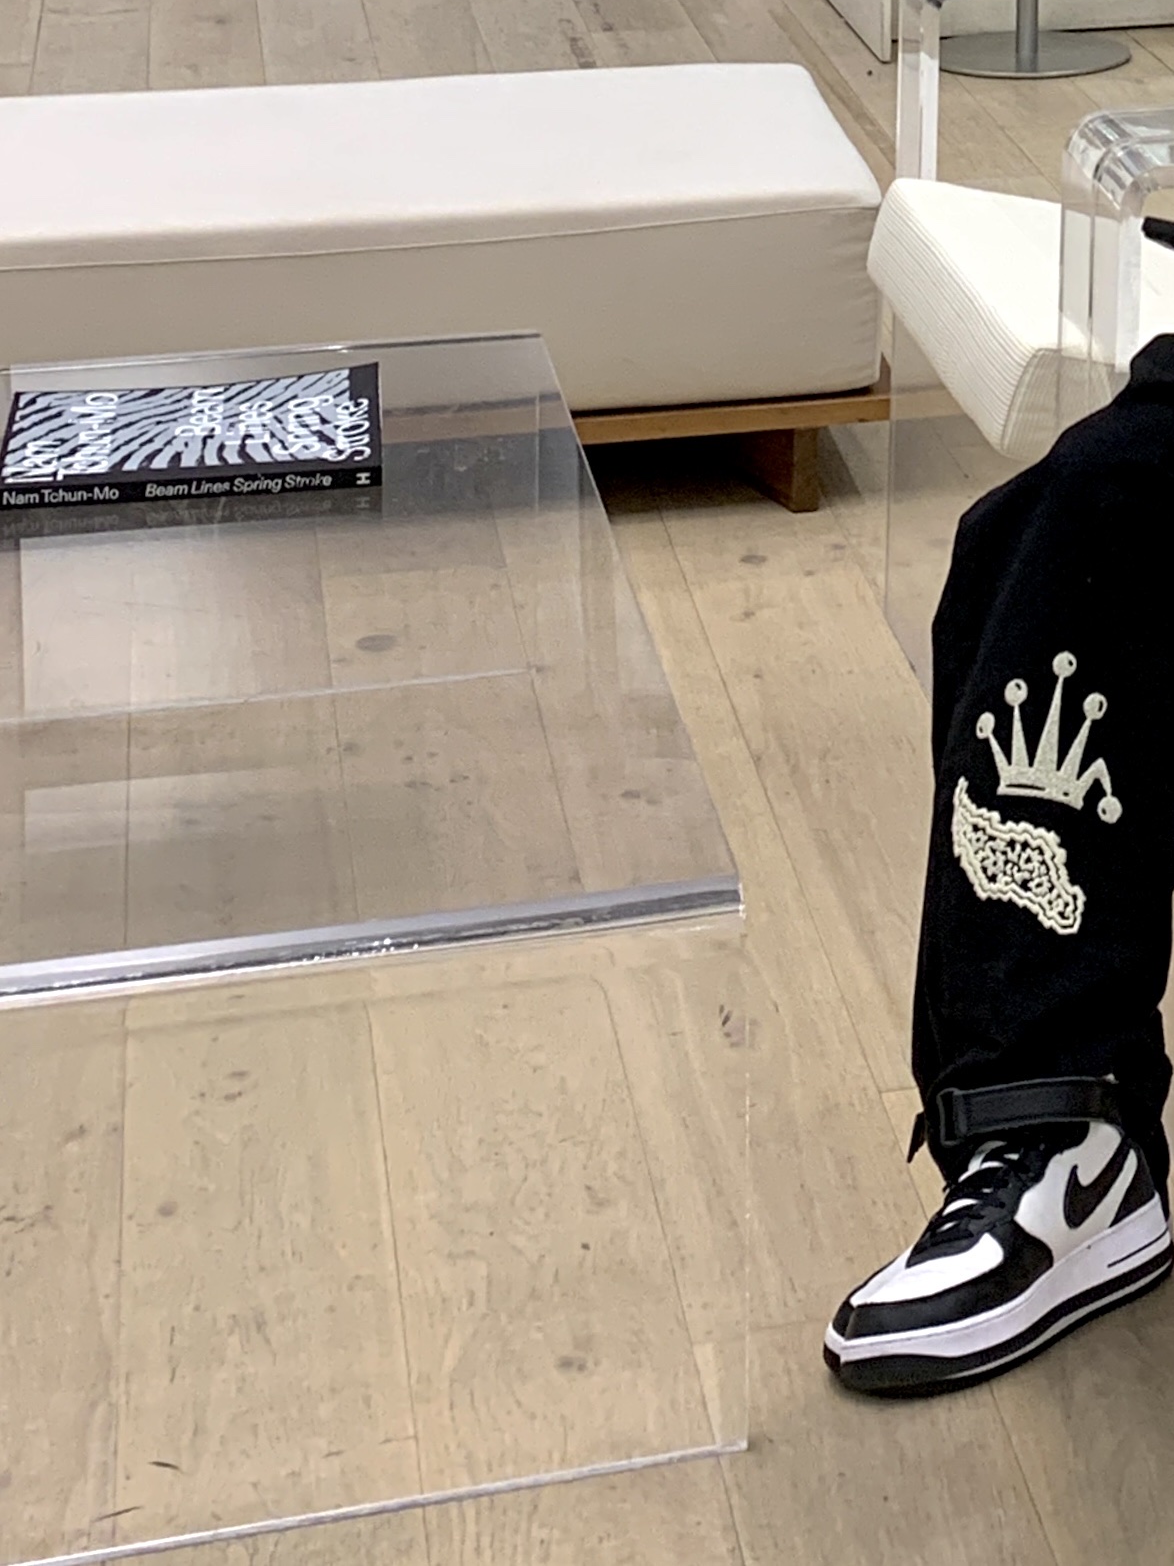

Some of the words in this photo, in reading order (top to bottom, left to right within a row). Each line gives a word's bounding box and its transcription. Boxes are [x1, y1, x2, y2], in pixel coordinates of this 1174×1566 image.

[2, 491, 39, 505] Nam
[41, 486, 120, 503] Tchun-Mo
[145, 482, 188, 497] Beam
[190, 480, 230, 495] Lines
[232, 473, 282, 493] Spring
[284, 472, 333, 489] Stroke
